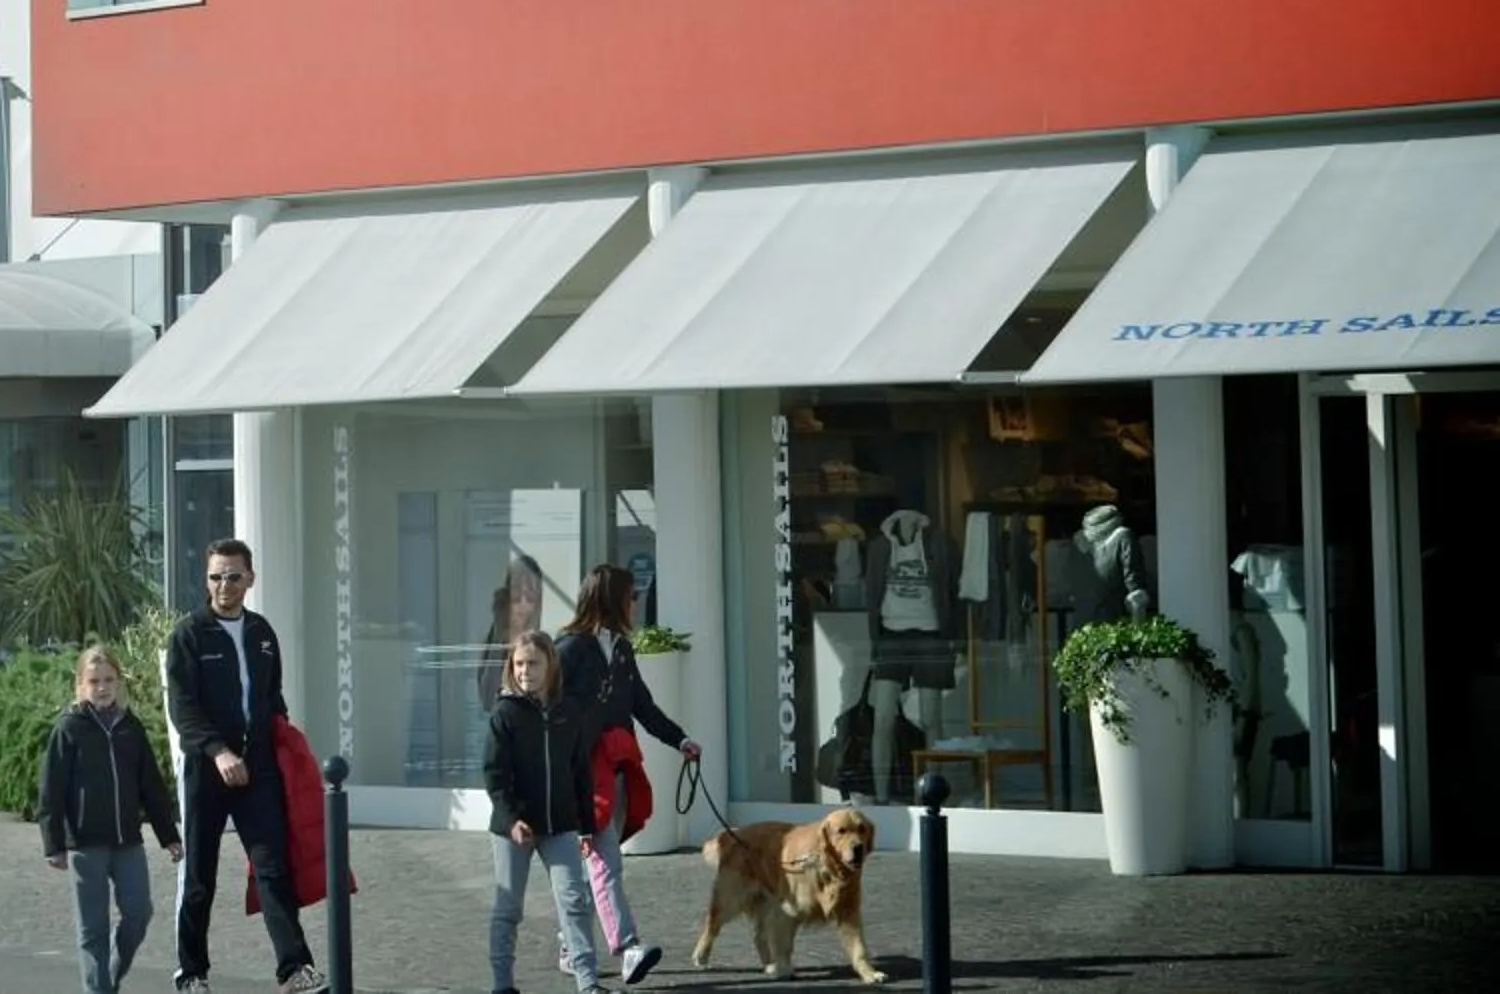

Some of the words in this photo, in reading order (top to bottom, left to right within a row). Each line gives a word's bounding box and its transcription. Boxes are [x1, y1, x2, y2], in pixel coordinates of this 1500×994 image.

[1111, 318, 1331, 342] NORTH
[333, 425, 350, 573] SAILS
[771, 414, 792, 573] SAILS
[337, 578, 354, 758] NORTH
[775, 580, 797, 775] NORTH
